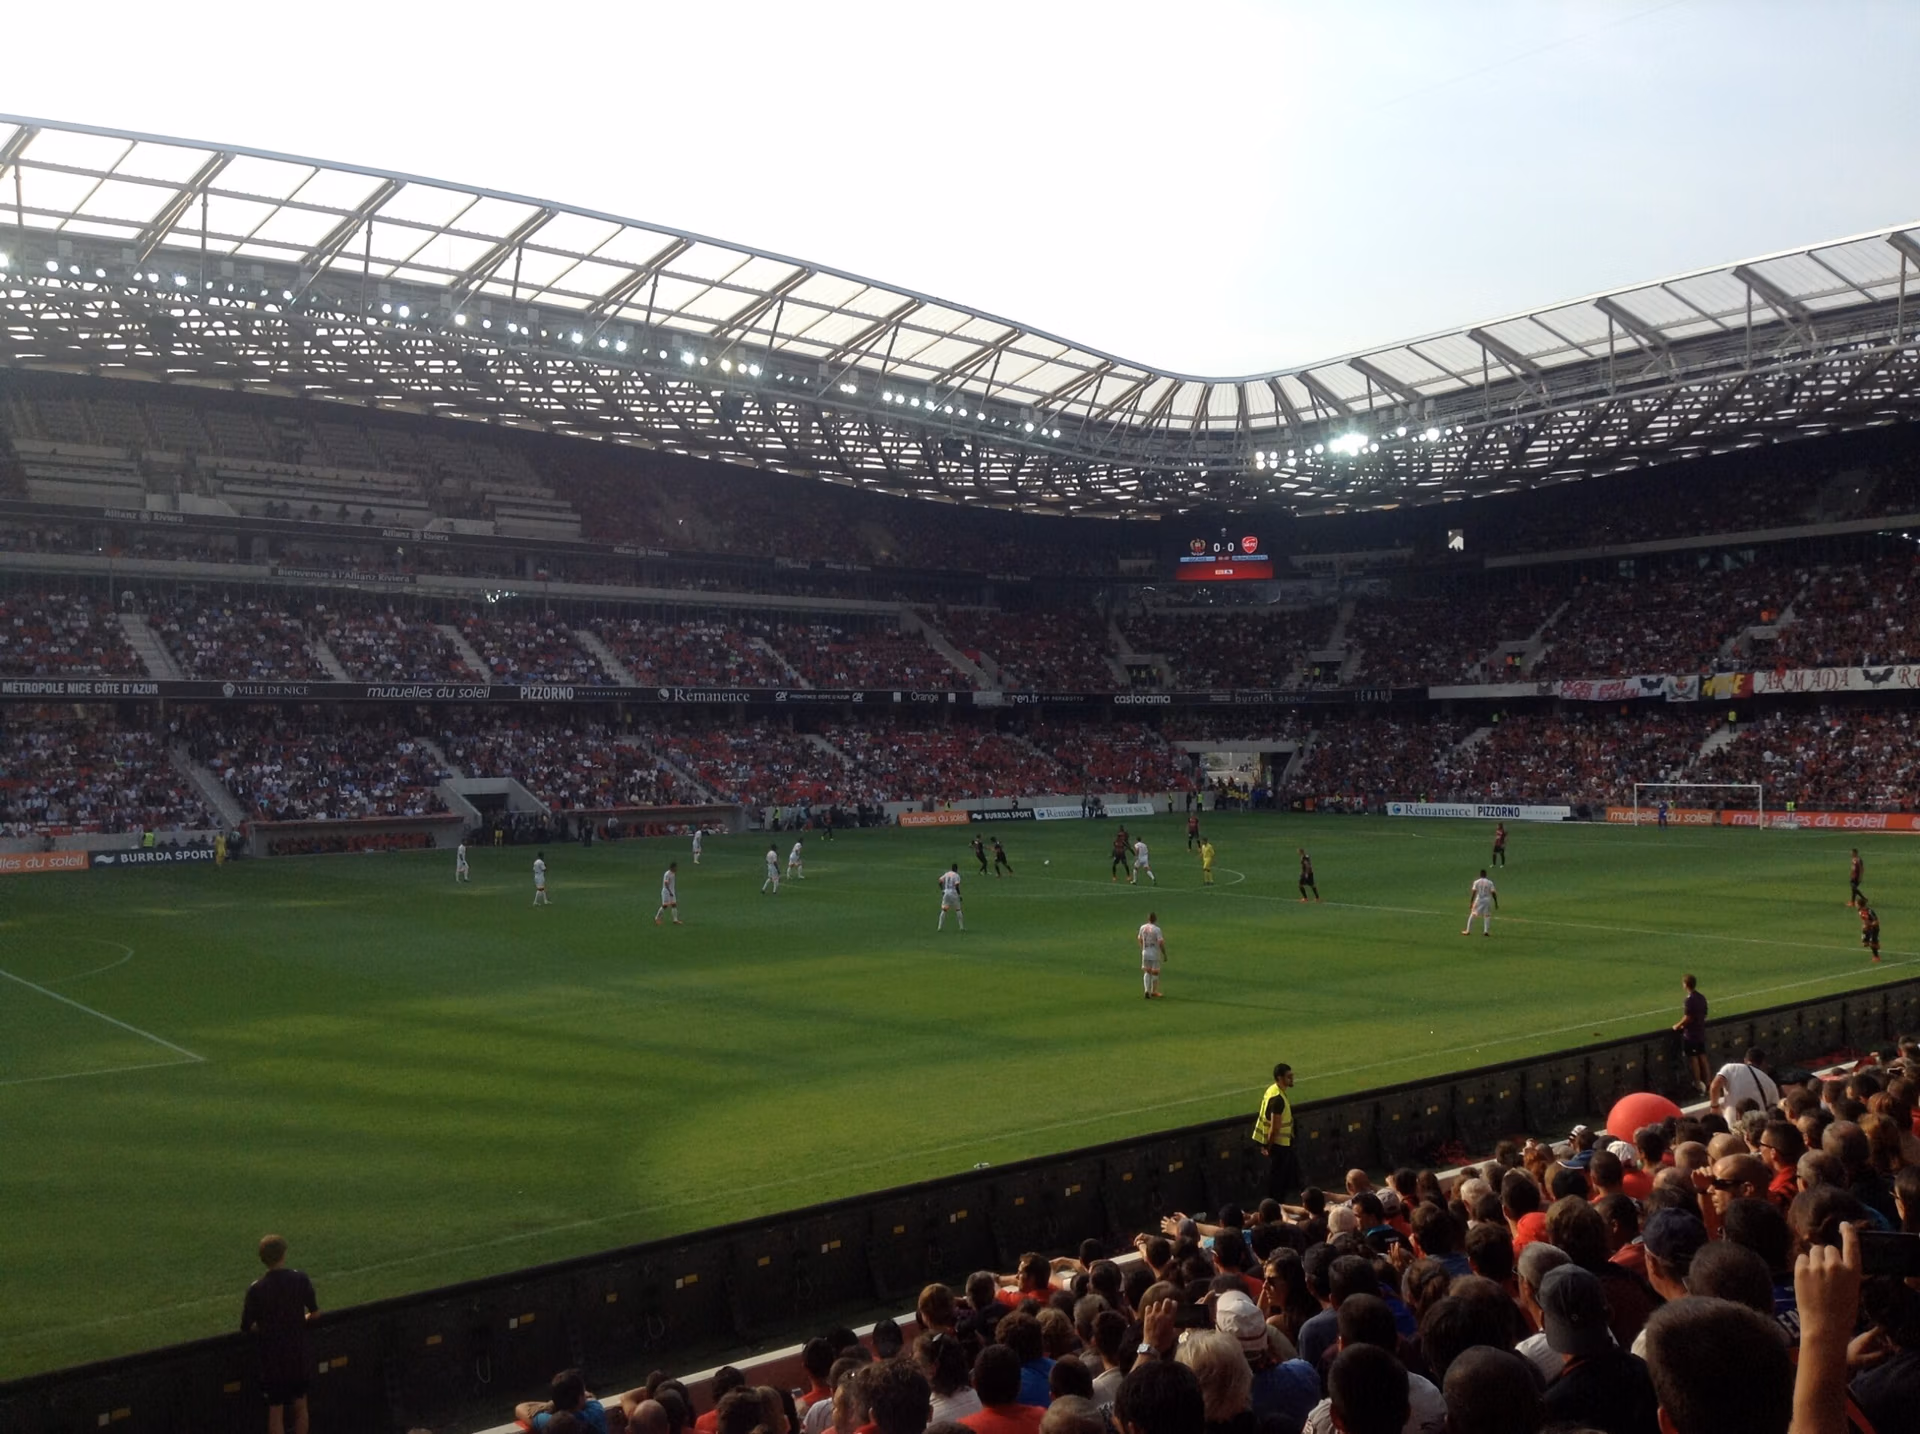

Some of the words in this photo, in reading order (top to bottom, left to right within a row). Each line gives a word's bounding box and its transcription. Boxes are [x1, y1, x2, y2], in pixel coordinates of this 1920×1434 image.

[104, 509, 137, 519] Allianz
[153, 512, 184, 522] Riviera
[382, 529, 410, 539] Allianz
[423, 532, 449, 541] Riviera
[1213, 543, 1221, 553] 0
[1227, 542, 1235, 552] 0
[277, 568, 329, 578] Bienvenue
[338, 571, 376, 580] l'Allianz
[378, 574, 410, 583] Riviera
[2, 681, 65, 694] MÉTROPOLE
[67, 682, 91, 694] NICE
[95, 681, 119, 694] CÔTE
[122, 683, 158, 694] D'AZUR
[238, 686, 264, 695] VILLE
[267, 686, 281, 695] DE
[284, 686, 309, 695] NICE
[367, 686, 433, 698] mutuelles
[436, 686, 455, 698] du
[457, 686, 491, 699] soleil
[520, 686, 574, 699] PIZZORNO
[674, 689, 750, 702] Rémanence
[911, 691, 939, 703] Orange
[1114, 694, 1171, 704] castorama
[984, 812, 1011, 820] BURRDA
[1012, 811, 1033, 819] SPORT
[1405, 804, 1471, 817] Rémanence
[1477, 806, 1520, 818] PIZZORNO
[902, 814, 937, 824] mutuelles
[938, 814, 949, 822] du
[950, 813, 967, 822] soleil
[1683, 812, 1713, 823] soleil
[1814, 815, 1838, 827] du
[1843, 814, 1887, 828] soleil
[25, 856, 45, 869] du
[48, 855, 85, 867] soleil
[120, 852, 173, 863] BURRDA
[174, 849, 215, 861] SPORT
